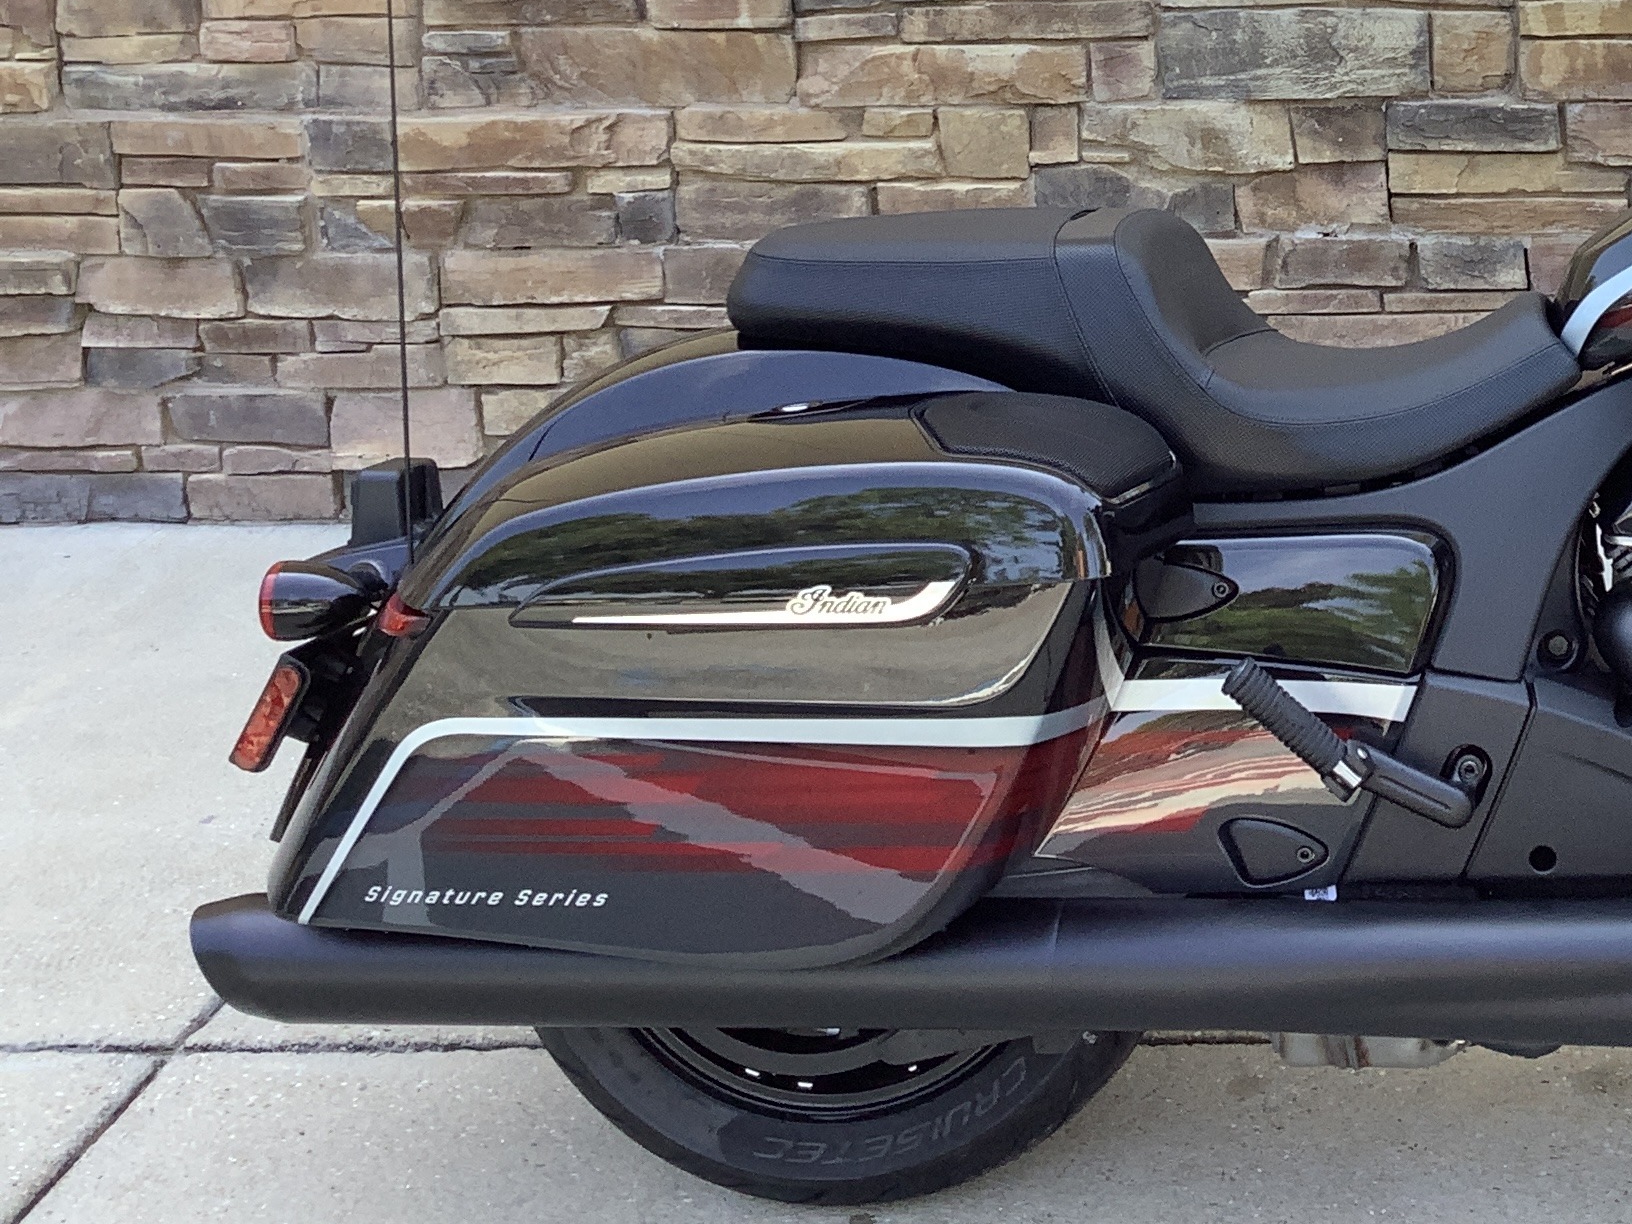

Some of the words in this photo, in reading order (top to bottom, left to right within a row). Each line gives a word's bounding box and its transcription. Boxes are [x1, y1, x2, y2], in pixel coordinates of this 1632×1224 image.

[788, 586, 888, 616] Indian
[364, 885, 504, 906] Signature
[513, 888, 610, 907] Series
[753, 1056, 1026, 1165] CRUISETEC
